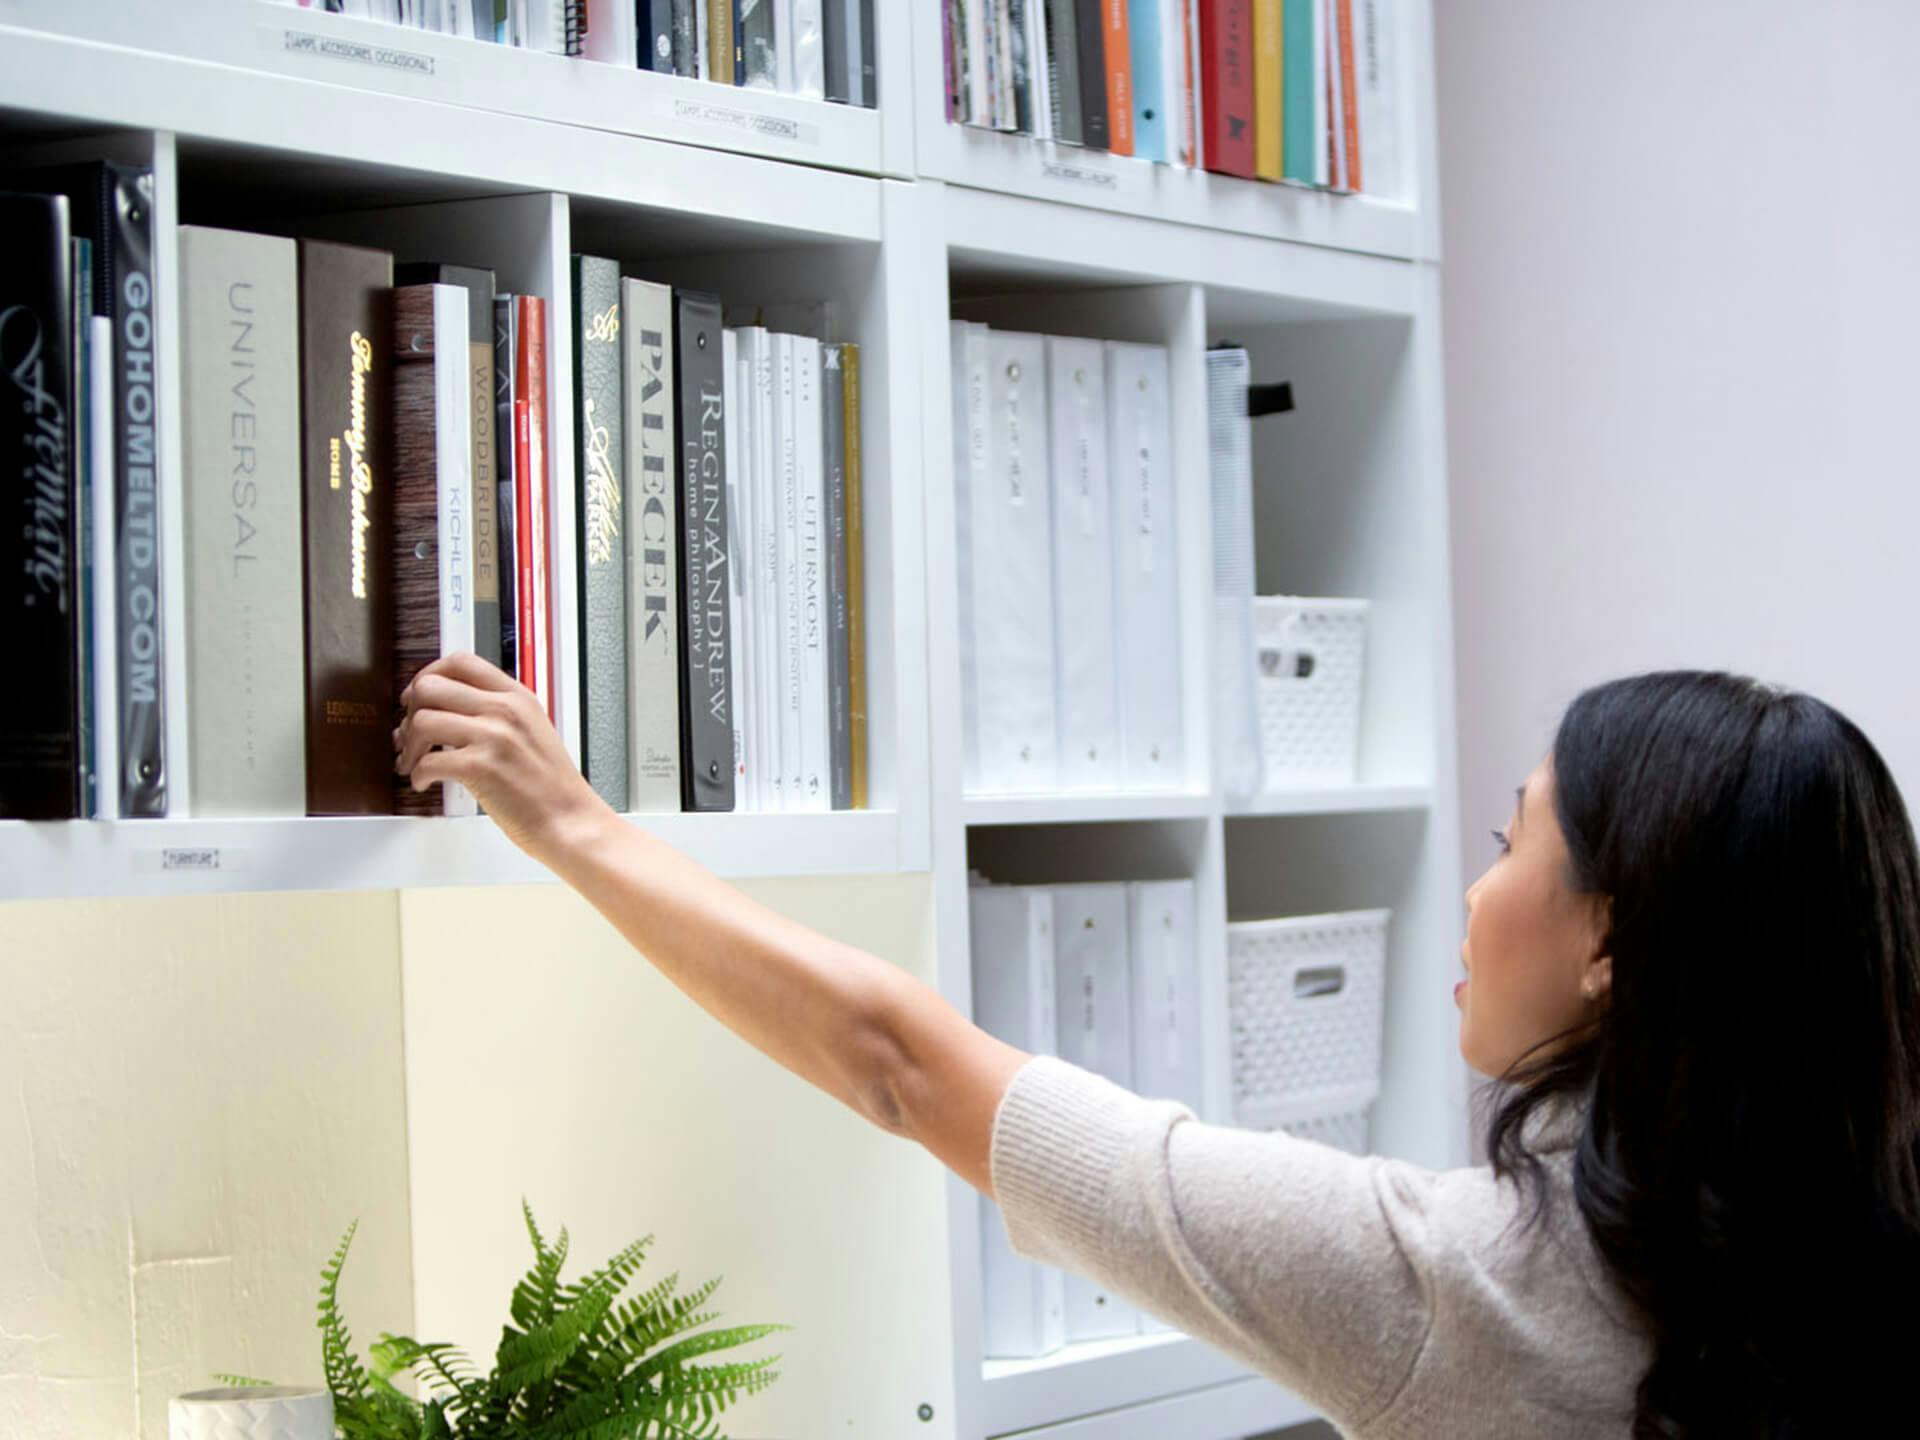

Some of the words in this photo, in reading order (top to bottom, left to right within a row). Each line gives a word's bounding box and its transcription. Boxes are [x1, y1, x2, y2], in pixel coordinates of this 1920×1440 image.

[228, 282, 257, 579] UNIVERSAL
[329, 437, 341, 490] HOME
[344, 330, 372, 452] Tommy
[123, 270, 157, 704] GOHOMELTD.COM
[350, 452, 373, 599] Bahama
[449, 487, 463, 613] KICHLER
[475, 365, 493, 580] WOODBRIDGE
[640, 328, 668, 656] PALECEK
[803, 494, 818, 650] UTTERMOST
